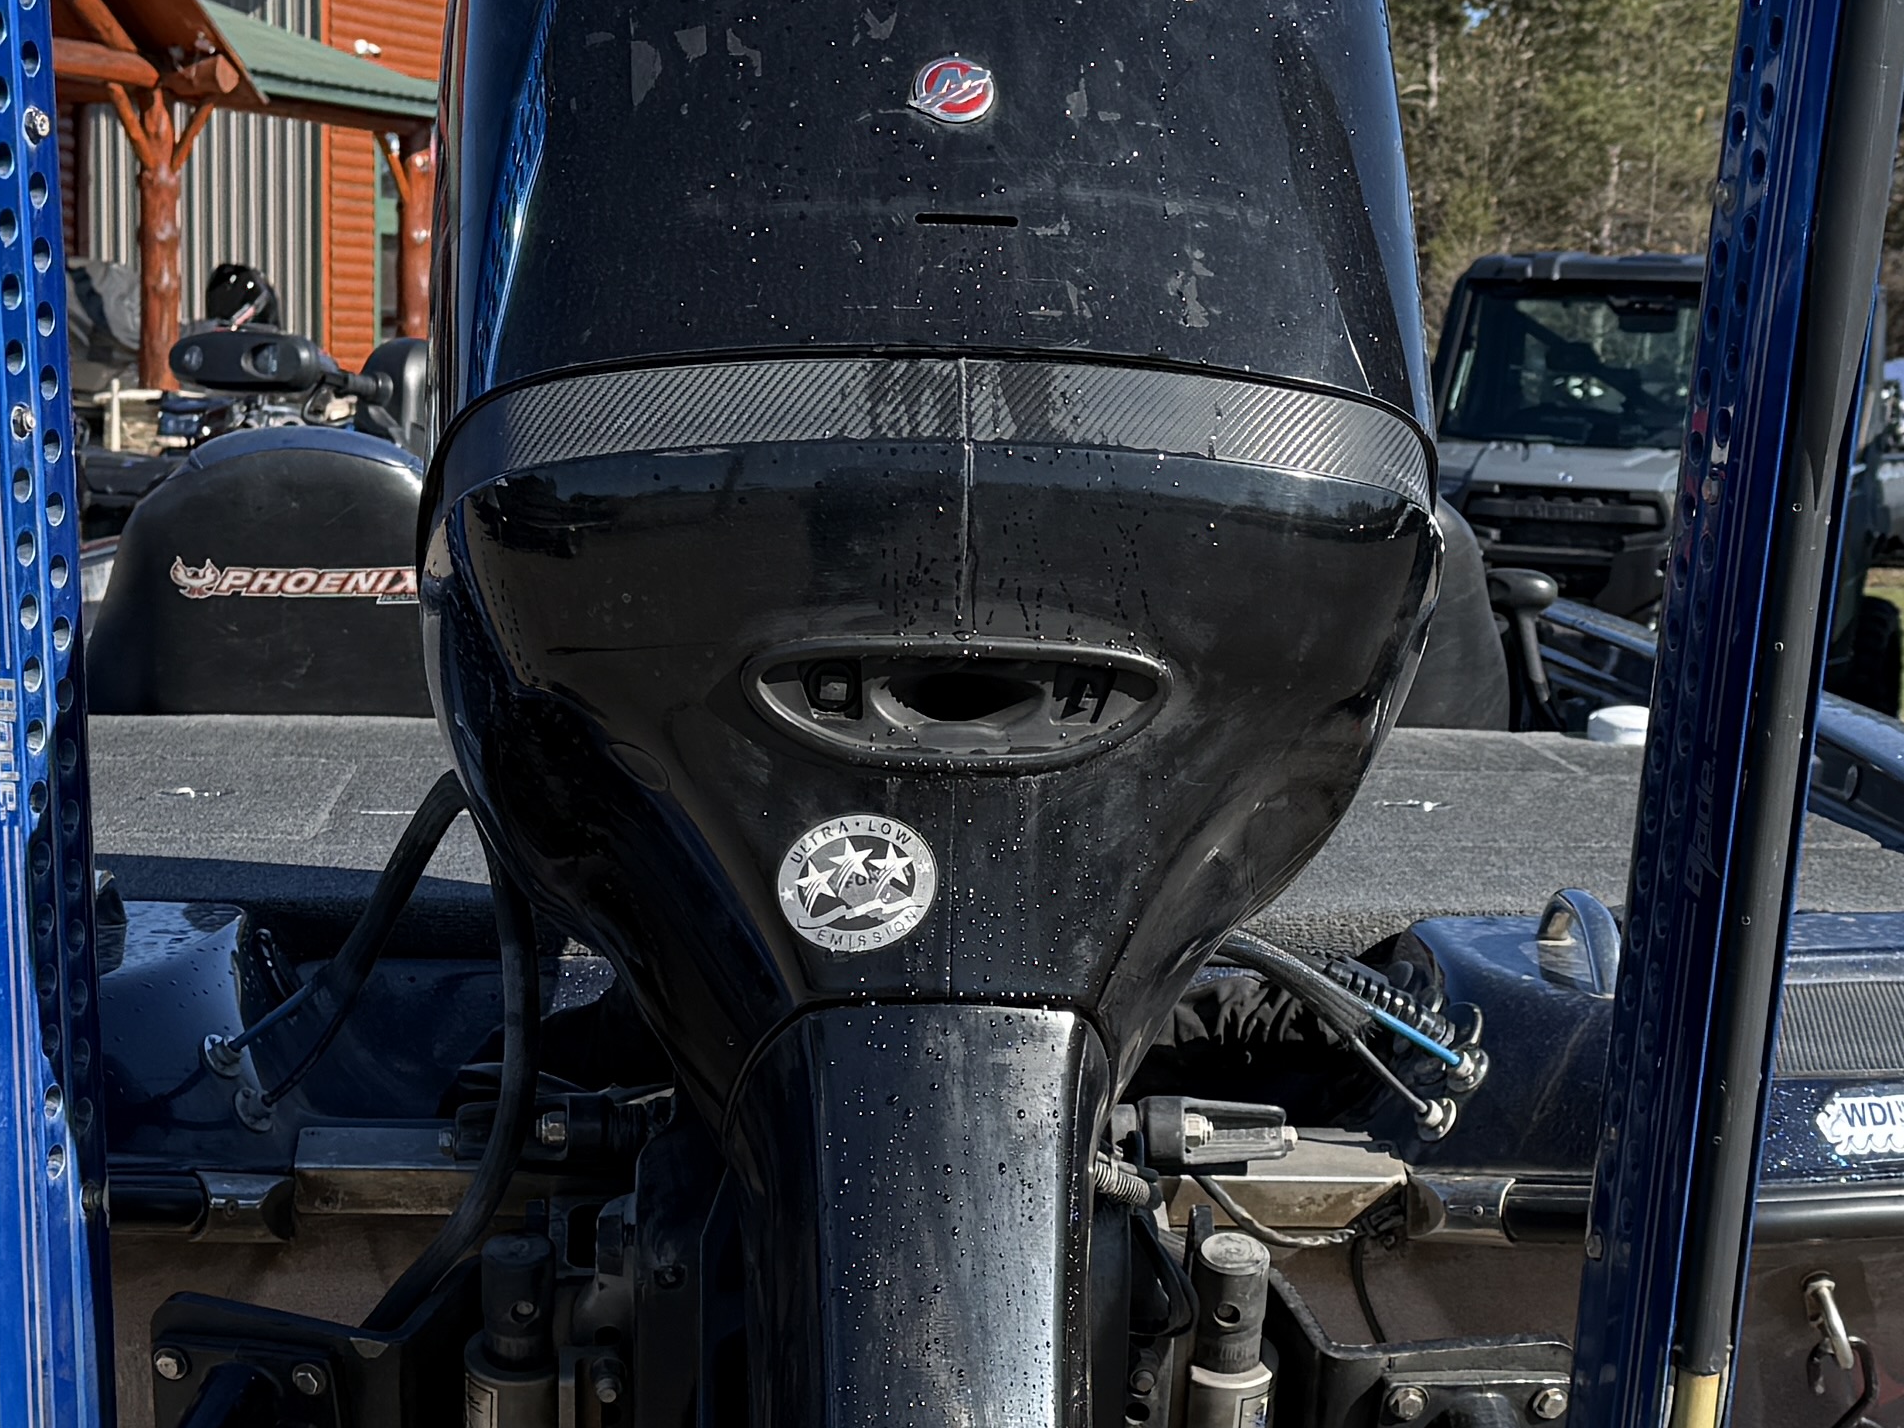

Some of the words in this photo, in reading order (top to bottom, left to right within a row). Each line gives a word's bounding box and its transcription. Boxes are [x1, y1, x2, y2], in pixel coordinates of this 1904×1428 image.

[790, 821, 849, 865] ULTRA
[867, 820, 912, 846] LOW
[816, 909, 919, 948] EMISSION
[1840, 1101, 1897, 1128] WDI
